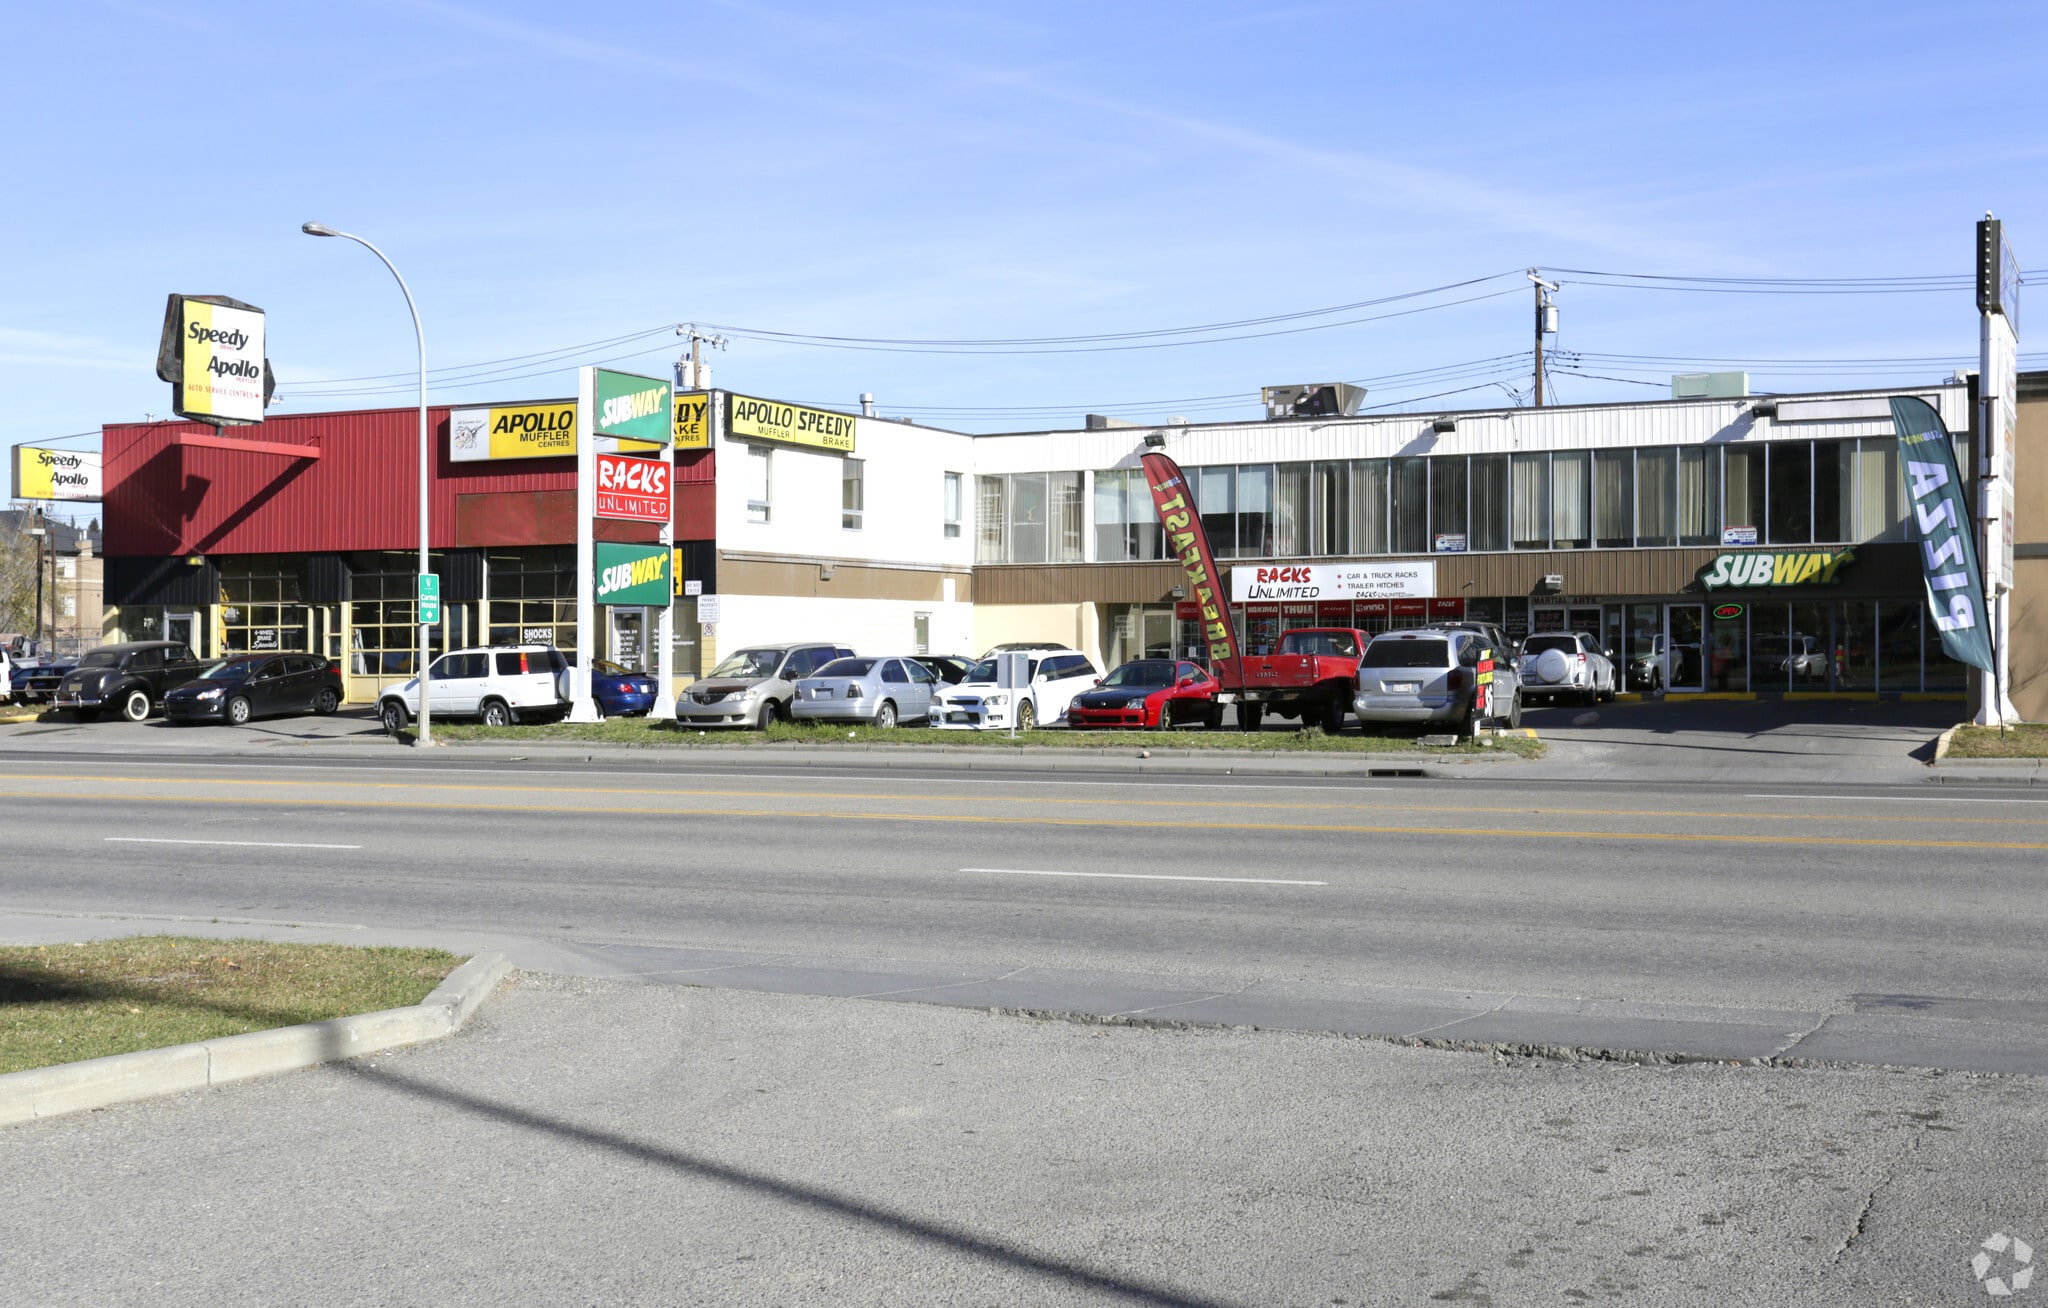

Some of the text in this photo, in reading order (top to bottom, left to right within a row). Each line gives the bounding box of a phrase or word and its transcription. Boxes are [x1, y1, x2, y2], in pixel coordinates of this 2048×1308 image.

[188, 322, 249, 351] Speedy
[207, 356, 260, 379] Apollo
[188, 384, 203, 392] AUTO
[205, 385, 227, 396] SERVICE
[600, 385, 668, 429] SUBWAY
[492, 410, 574, 434] APOLLO
[734, 400, 794, 429] APOLLO
[797, 410, 853, 438] SPEEDY
[520, 431, 570, 443] MUFFLER
[758, 426, 790, 439] MUFFLER
[538, 440, 570, 448] CENTRES
[822, 437, 850, 448] BRAKE
[37, 452, 82, 469] Speedy
[50, 471, 89, 486] Apollo
[600, 460, 667, 495] RACKS
[598, 496, 667, 515] UNLIMITED
[598, 552, 668, 597] SUBWAY
[1257, 566, 1312, 584] RACKS
[1704, 551, 1855, 587] SUBWAY
[1248, 585, 1320, 599] UNLIMITED
[1283, 605, 1314, 614] THULE
[1717, 606, 1739, 615] OPEN
[524, 628, 553, 639] SHOCKS
[252, 641, 278, 649] Specials
